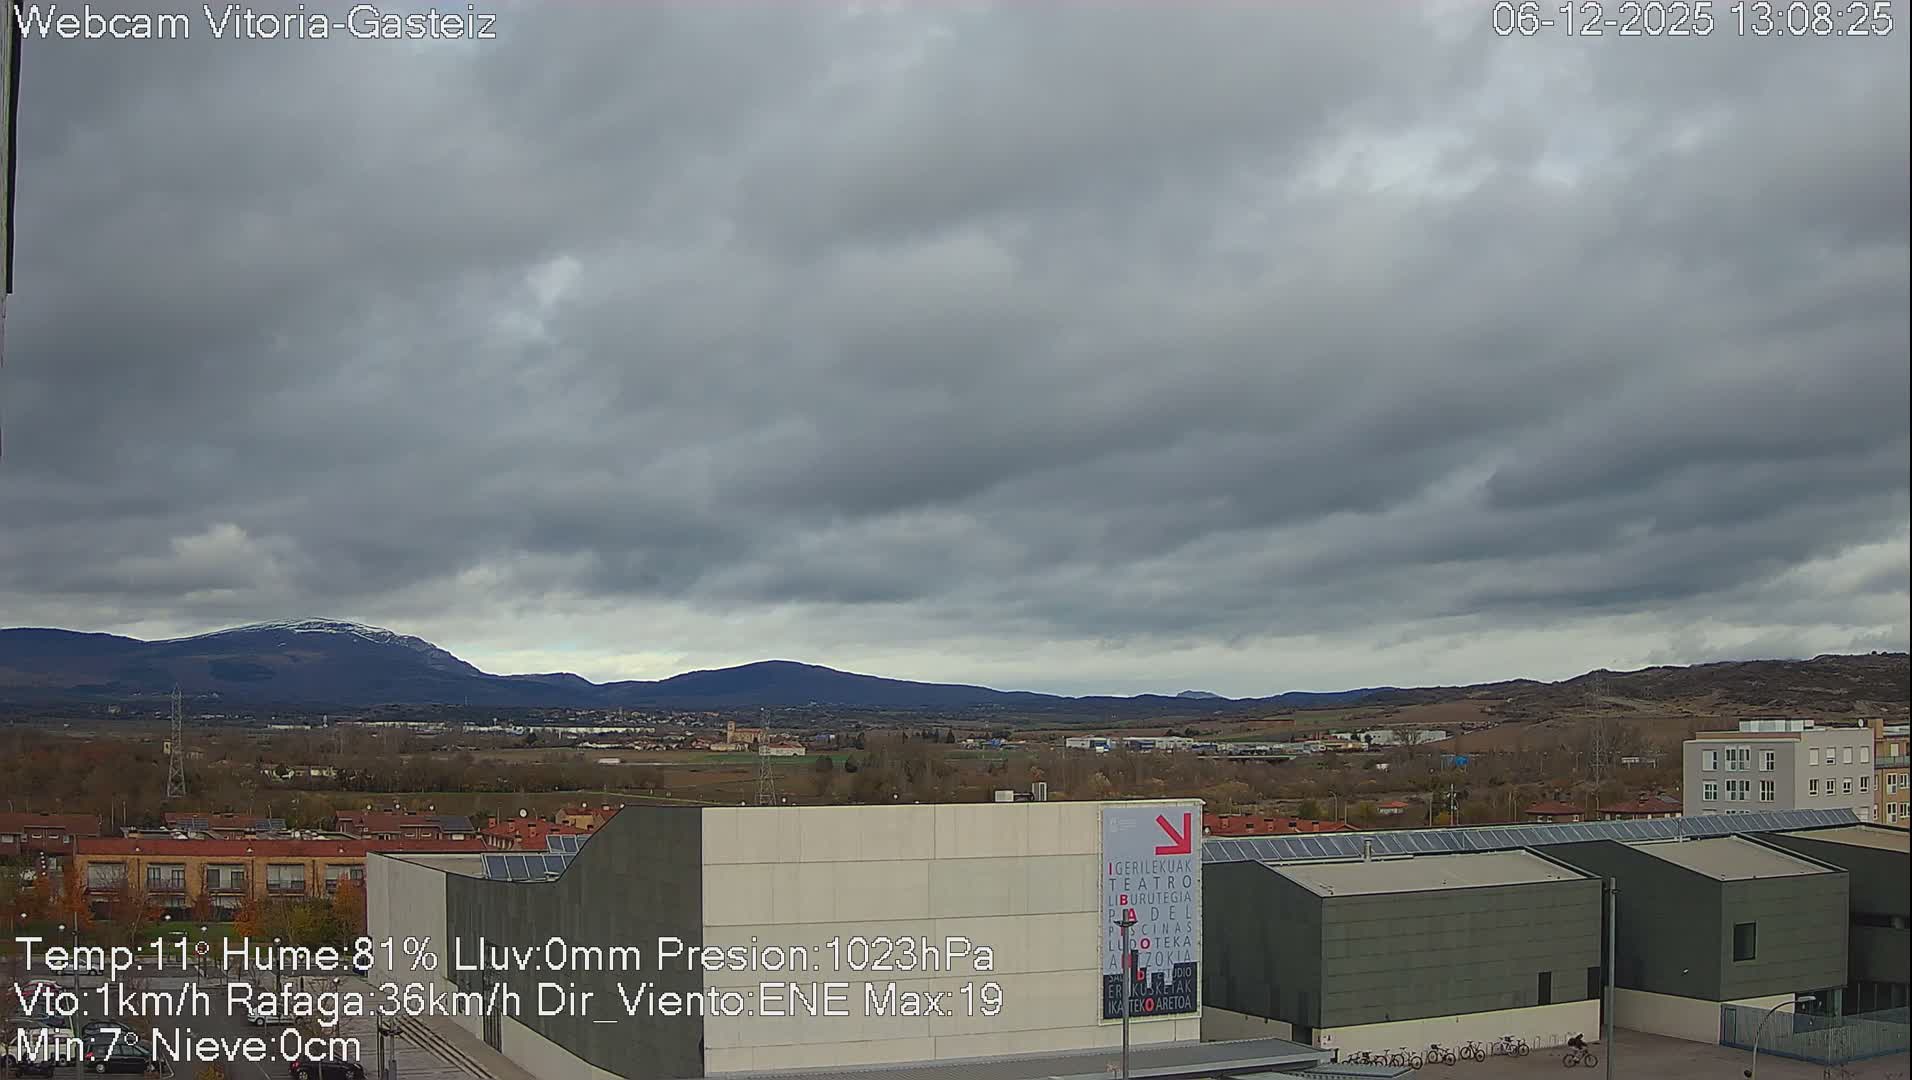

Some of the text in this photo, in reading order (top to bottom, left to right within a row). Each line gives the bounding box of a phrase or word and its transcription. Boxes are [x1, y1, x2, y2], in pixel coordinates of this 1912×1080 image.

[1108, 859, 1192, 876] IGERILEKUAK
[1108, 874, 1192, 892] TEATRO
[1108, 890, 1192, 907] LIBURUTEGIA
[1108, 904, 1192, 923] PADEL
[1108, 935, 1192, 952] LUDOTEKA
[1108, 979, 1192, 999] ERKUSKETAK
[1108, 995, 1192, 1015] IKATEKO ARETOA
